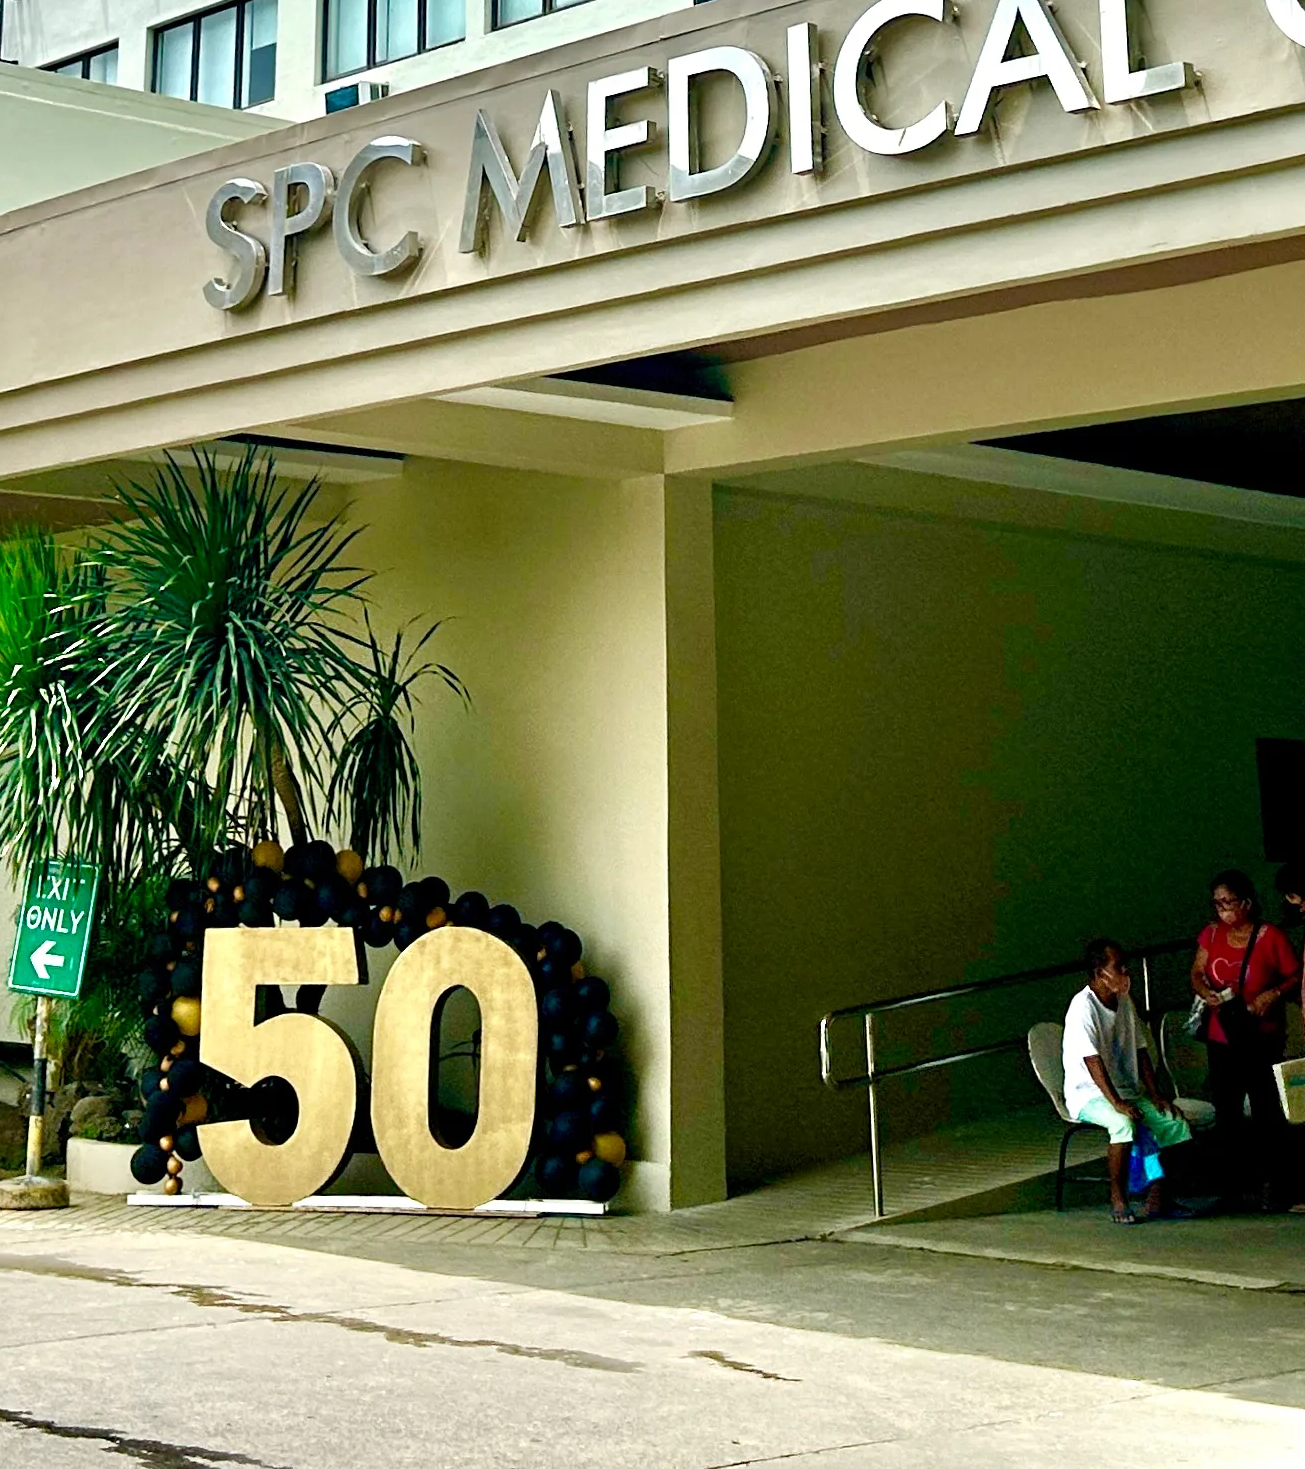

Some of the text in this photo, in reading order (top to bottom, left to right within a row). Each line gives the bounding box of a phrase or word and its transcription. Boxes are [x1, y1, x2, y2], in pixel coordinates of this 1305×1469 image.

[202, 134, 427, 311] SPC
[26, 905, 85, 934] ONLY
[196, 926, 540, 1210] 50
